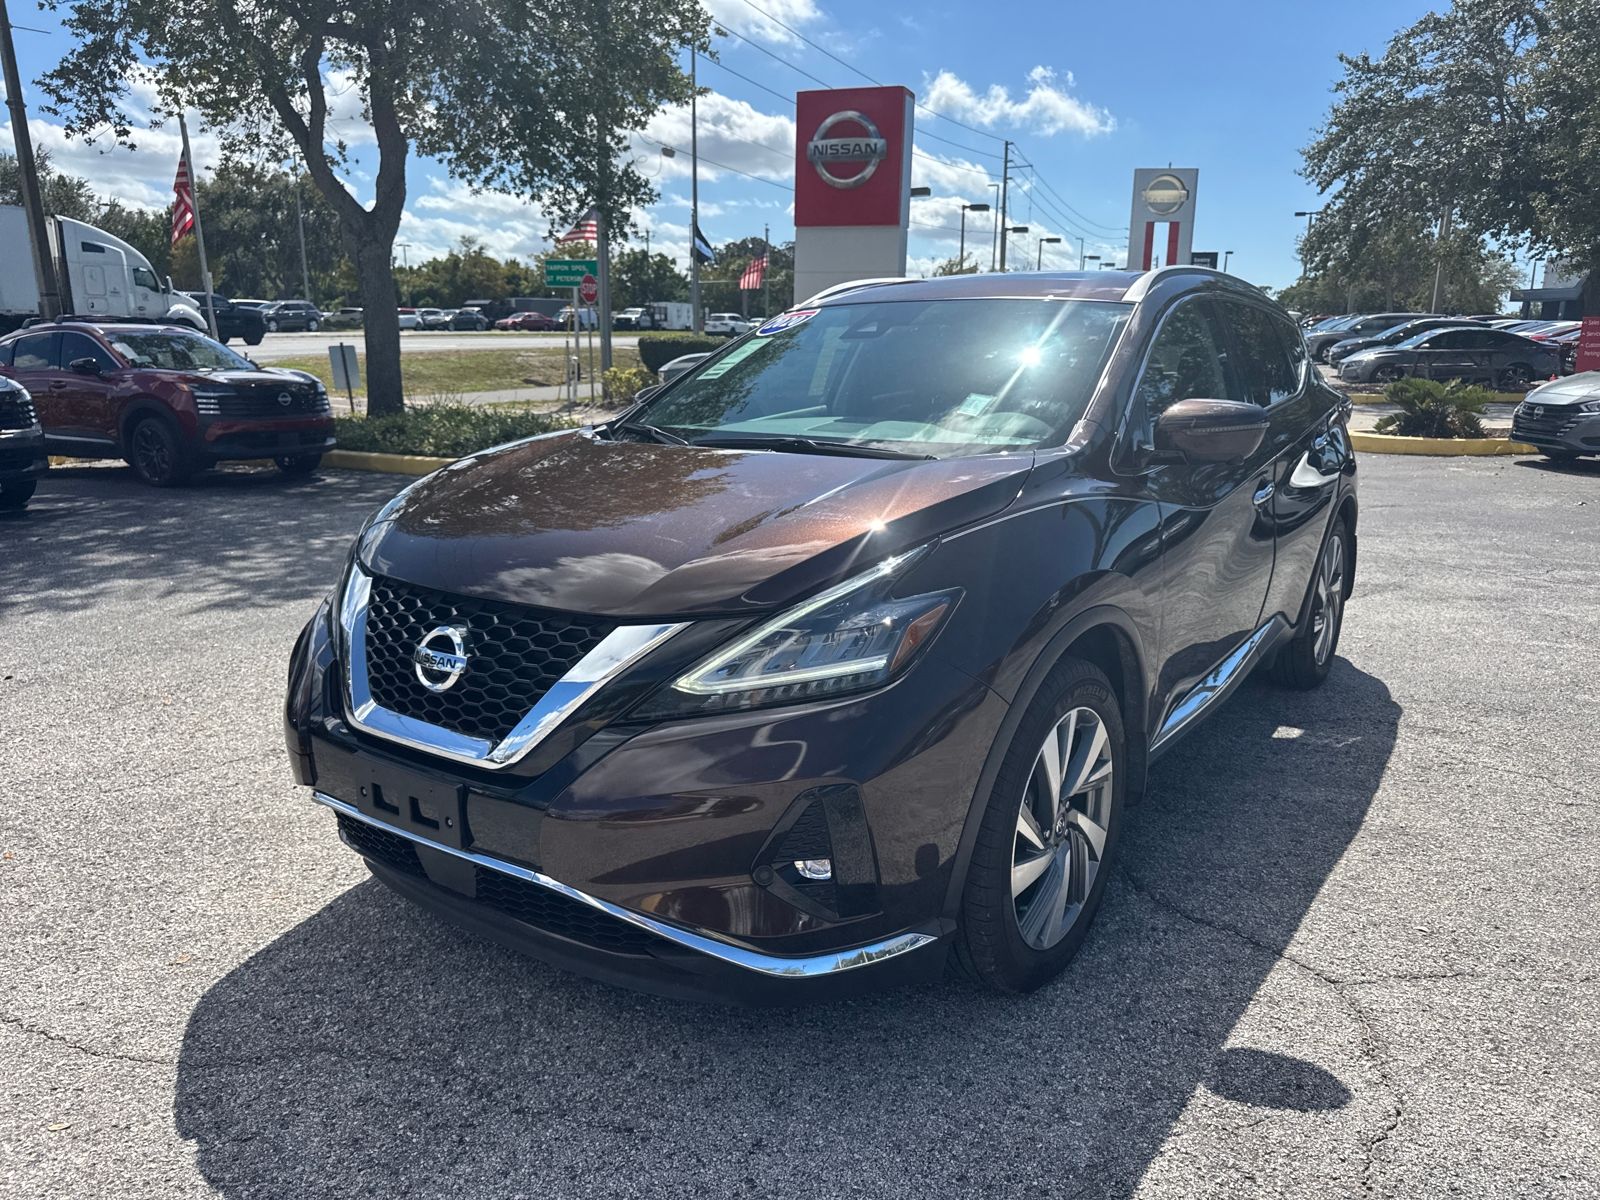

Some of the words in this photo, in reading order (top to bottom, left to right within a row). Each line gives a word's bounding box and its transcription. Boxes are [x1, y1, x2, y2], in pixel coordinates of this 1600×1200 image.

[813, 143, 878, 156] NISSAN
[582, 283, 597, 294] STOP
[414, 650, 457, 669] NISSAN
